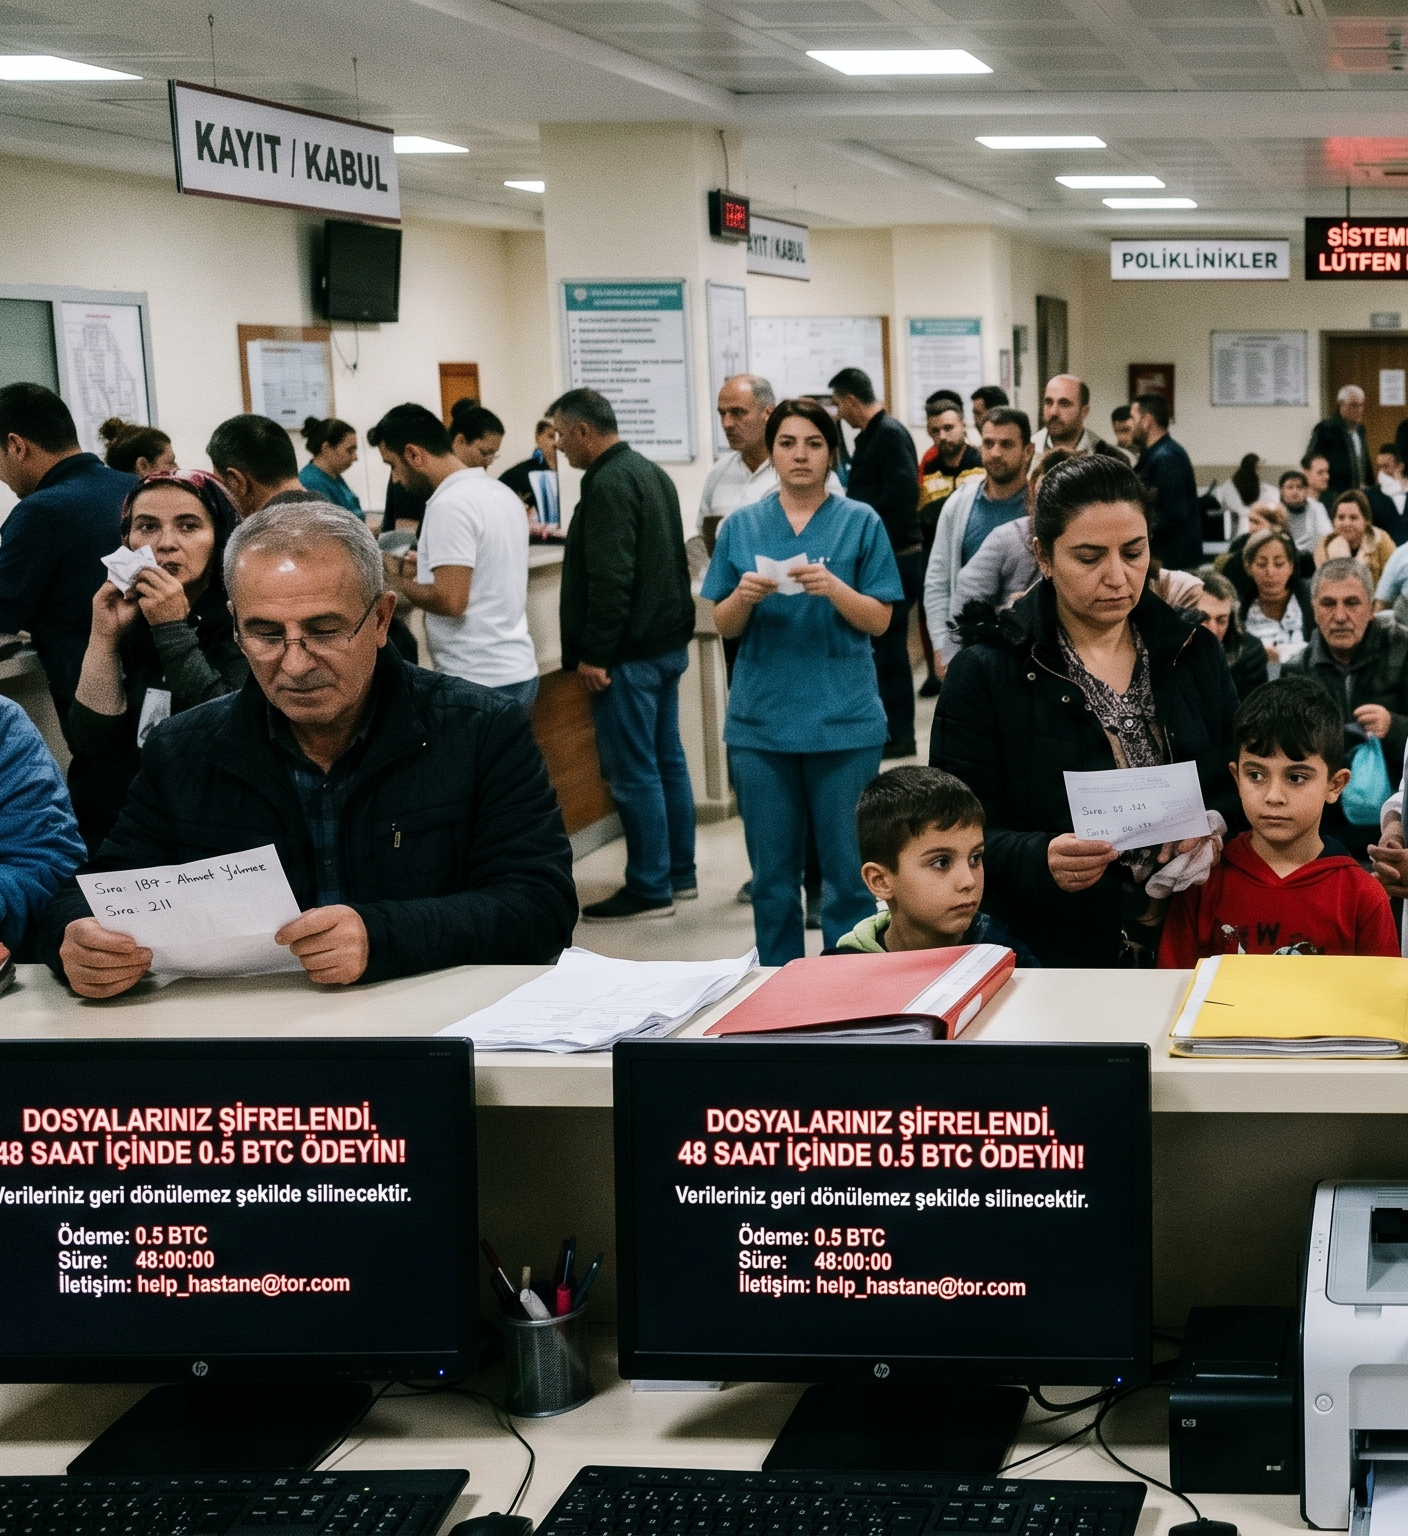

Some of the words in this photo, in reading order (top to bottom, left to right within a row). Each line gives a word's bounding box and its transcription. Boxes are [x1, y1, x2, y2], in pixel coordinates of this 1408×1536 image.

[195, 120, 281, 174] KAYIT
[290, 139, 297, 178] /
[304, 141, 389, 193] KABUL
[747, 233, 767, 257] AYIT
[775, 237, 805, 264] KABUL
[1122, 248, 1279, 270] POLİKLİNİKLER
[1319, 246, 1401, 272] LÜTFEN
[148, 899, 172, 911] 211
[23, 1107, 213, 1134] DOSYALARINIZ
[219, 1102, 377, 1136] ŞİFRELENDİ.
[707, 1109, 892, 1135] DOSYALARINIZ
[899, 1105, 1055, 1140] ŞİFRELENDİ.
[30, 1141, 98, 1166] SAAT
[105, 1134, 191, 1170] İÇİNDE
[200, 1141, 235, 1165] 0.5
[243, 1140, 294, 1164] BTC
[301, 1134, 406, 1164] ÖDEYİN!
[677, 1142, 706, 1165] 48
[714, 1142, 781, 1166] SAAT
[787, 1137, 871, 1172] İÇİNDE
[878, 1144, 915, 1168] 0.5
[922, 1144, 973, 1169] BTC
[980, 1138, 1085, 1170] ÖDEYİN!
[89, 1187, 125, 1209] geri
[130, 1185, 231, 1205] dönülemez
[236, 1185, 302, 1207] şekilde
[306, 1184, 412, 1203] silinecektir.
[675, 1185, 766, 1206] Verileriniz
[770, 1187, 806, 1210] geri
[810, 1187, 911, 1208] dönülemez
[915, 1189, 980, 1212] şekilde
[985, 1189, 1089, 1209] silinecektir.
[58, 1223, 130, 1246] Ödeme:
[135, 1226, 163, 1245] 0.5
[168, 1226, 208, 1244] BTC
[738, 1222, 809, 1247] Ödeme:
[814, 1229, 841, 1247] 0.5
[847, 1229, 886, 1248] BTC
[58, 1251, 107, 1270] Süre:
[136, 1250, 214, 1269] 48:00:00
[738, 1250, 787, 1270] Süre:
[814, 1252, 892, 1271] 48:00:00
[59, 1271, 131, 1297] İletişim:
[137, 1274, 350, 1298] help_hastane@tor.com
[739, 1271, 811, 1299] İletişim:
[817, 1276, 1026, 1300] help_hastane@tor.com
